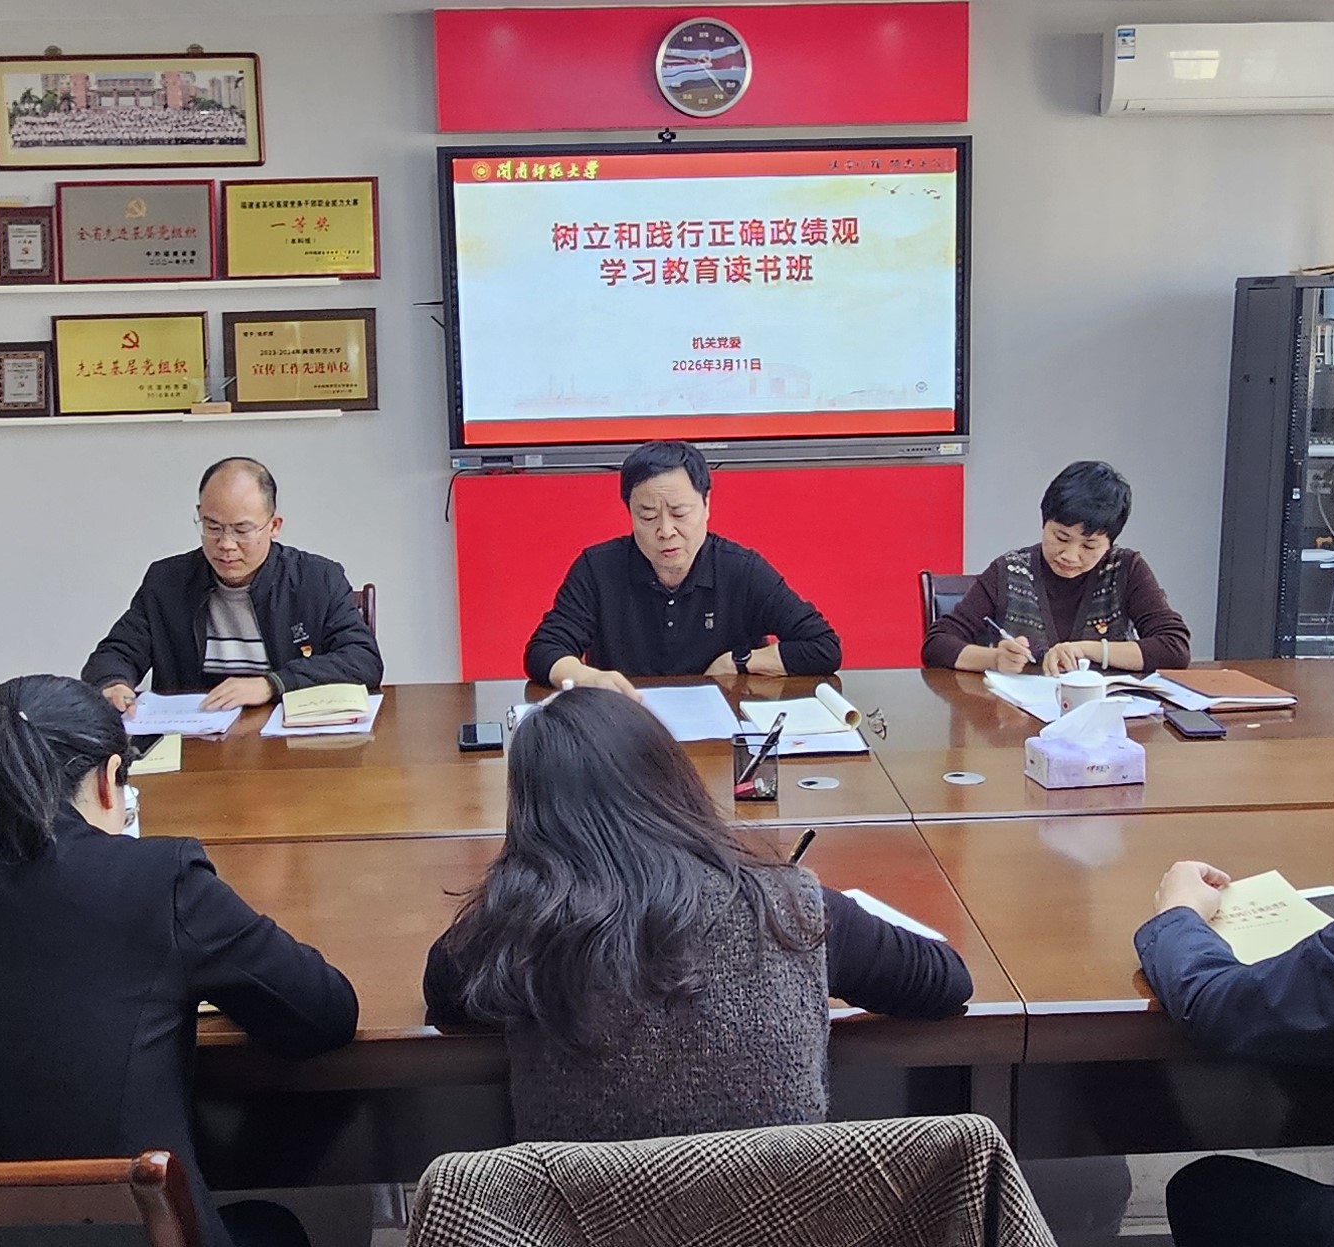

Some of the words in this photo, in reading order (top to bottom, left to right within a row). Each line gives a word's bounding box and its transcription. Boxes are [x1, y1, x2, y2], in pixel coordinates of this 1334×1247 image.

[496, 160, 600, 181] 闽南师范大学
[77, 224, 198, 242] 全省先进基层党组织
[270, 215, 330, 233] 一等奖
[551, 217, 860, 251] 树立和践行正确政绩观
[599, 254, 814, 286] 学习教育读书班
[692, 336, 741, 350] 机关党委
[75, 358, 188, 377] 先进基层党组织
[252, 361, 351, 376] 宣传工作先进单位
[672, 358, 761, 372] 2026年3月11日
